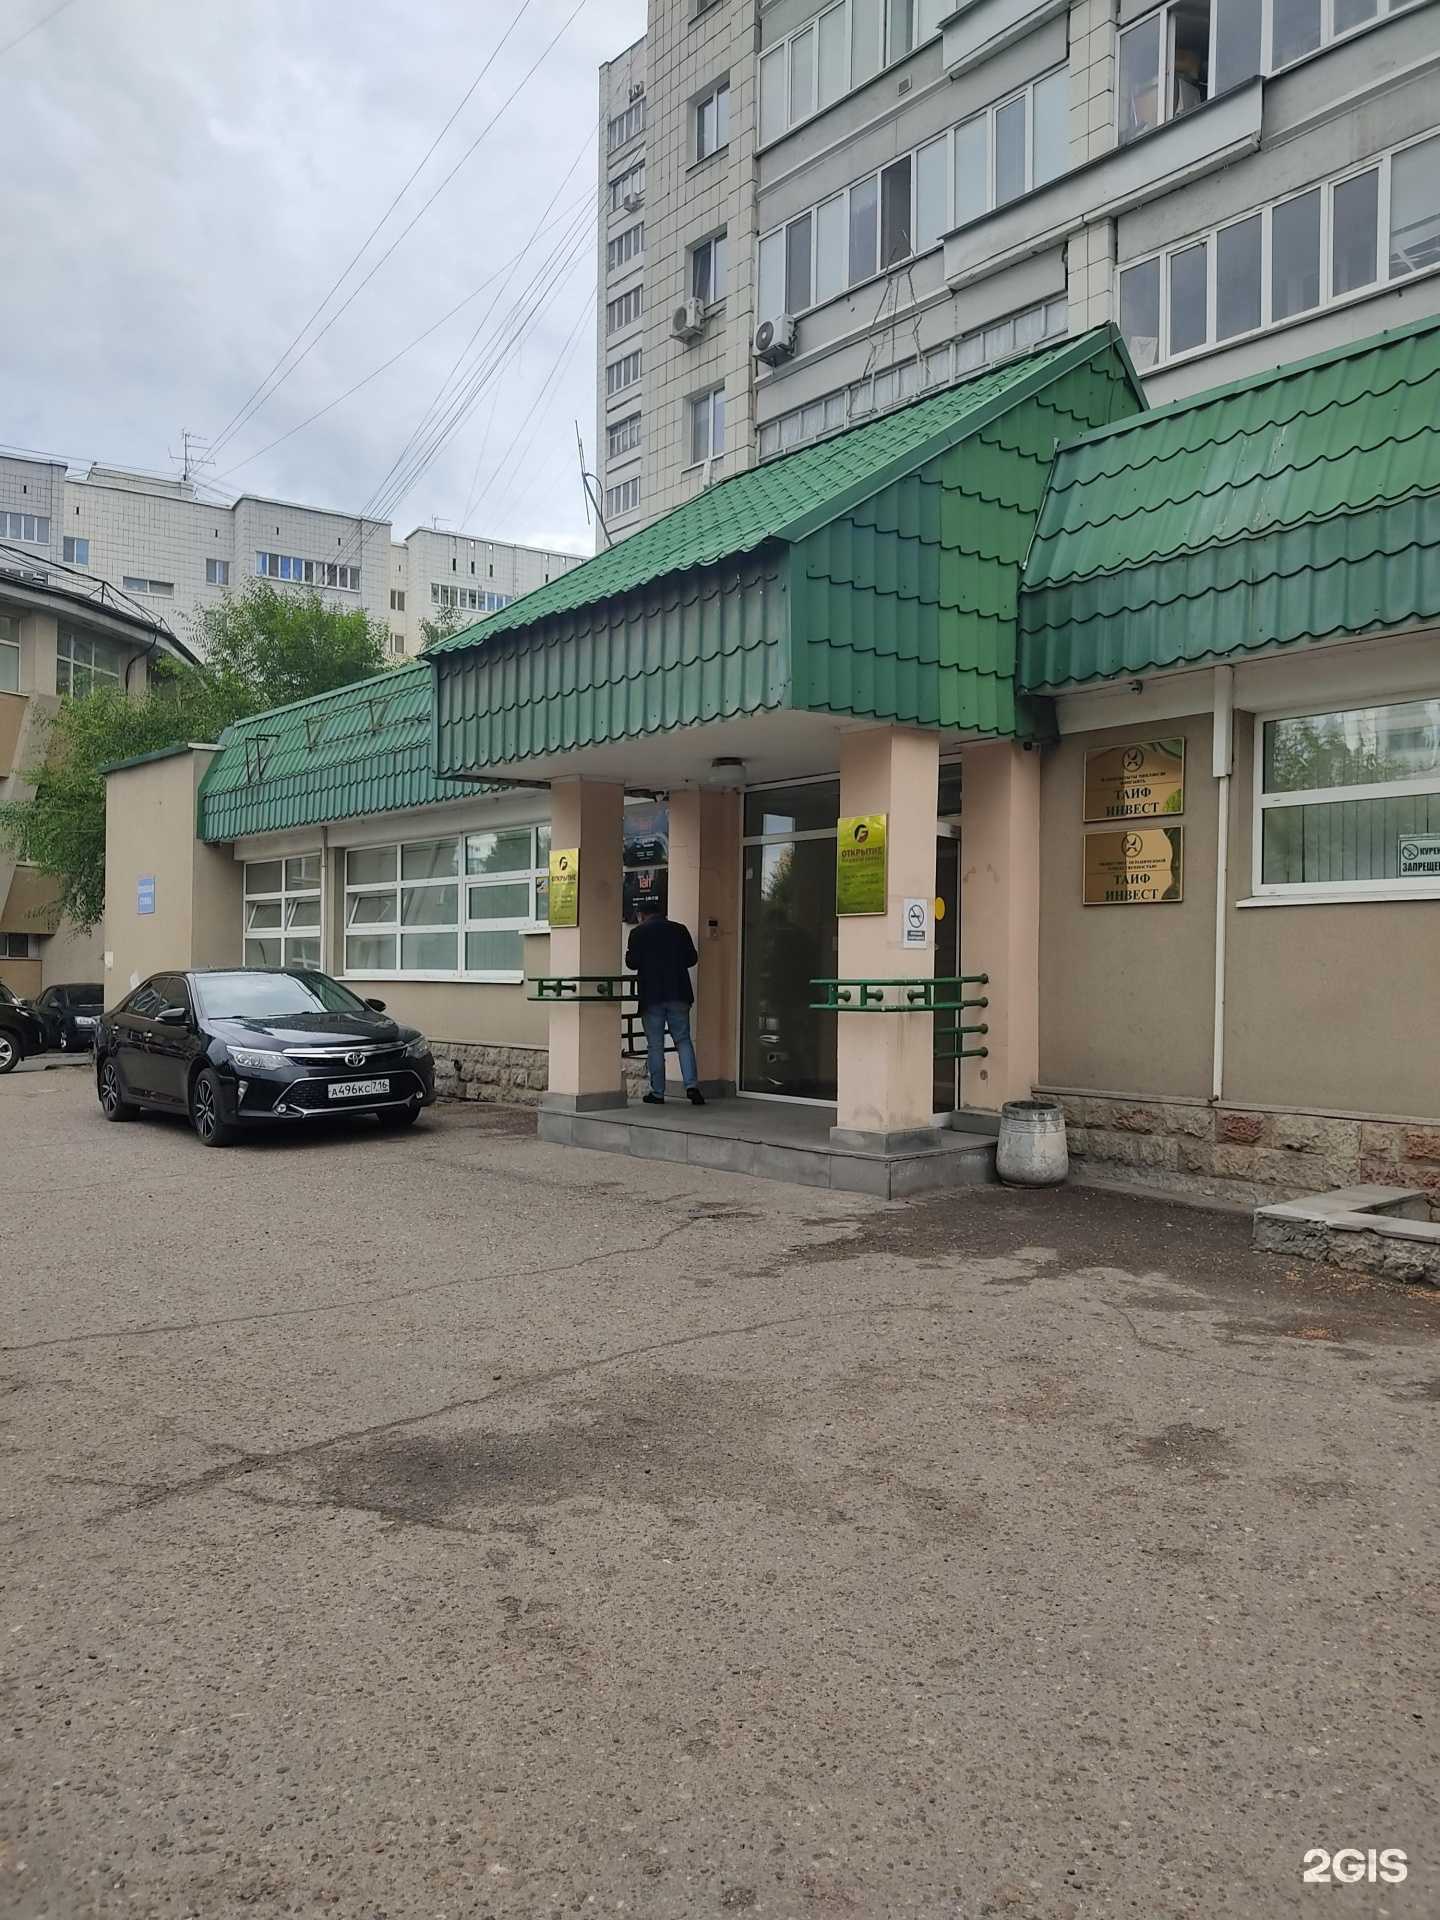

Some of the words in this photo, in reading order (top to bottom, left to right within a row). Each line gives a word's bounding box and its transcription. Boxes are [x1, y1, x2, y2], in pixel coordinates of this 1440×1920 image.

[1115, 787, 1151, 800] ТАИФ
[1106, 802, 1160, 817] ИНВЕСТ
[1402, 862, 1440, 871] ЗАПРЕЩЕ
[1114, 873, 1151, 885] ТАИФ
[1105, 888, 1160, 902] ИНВЕСТ
